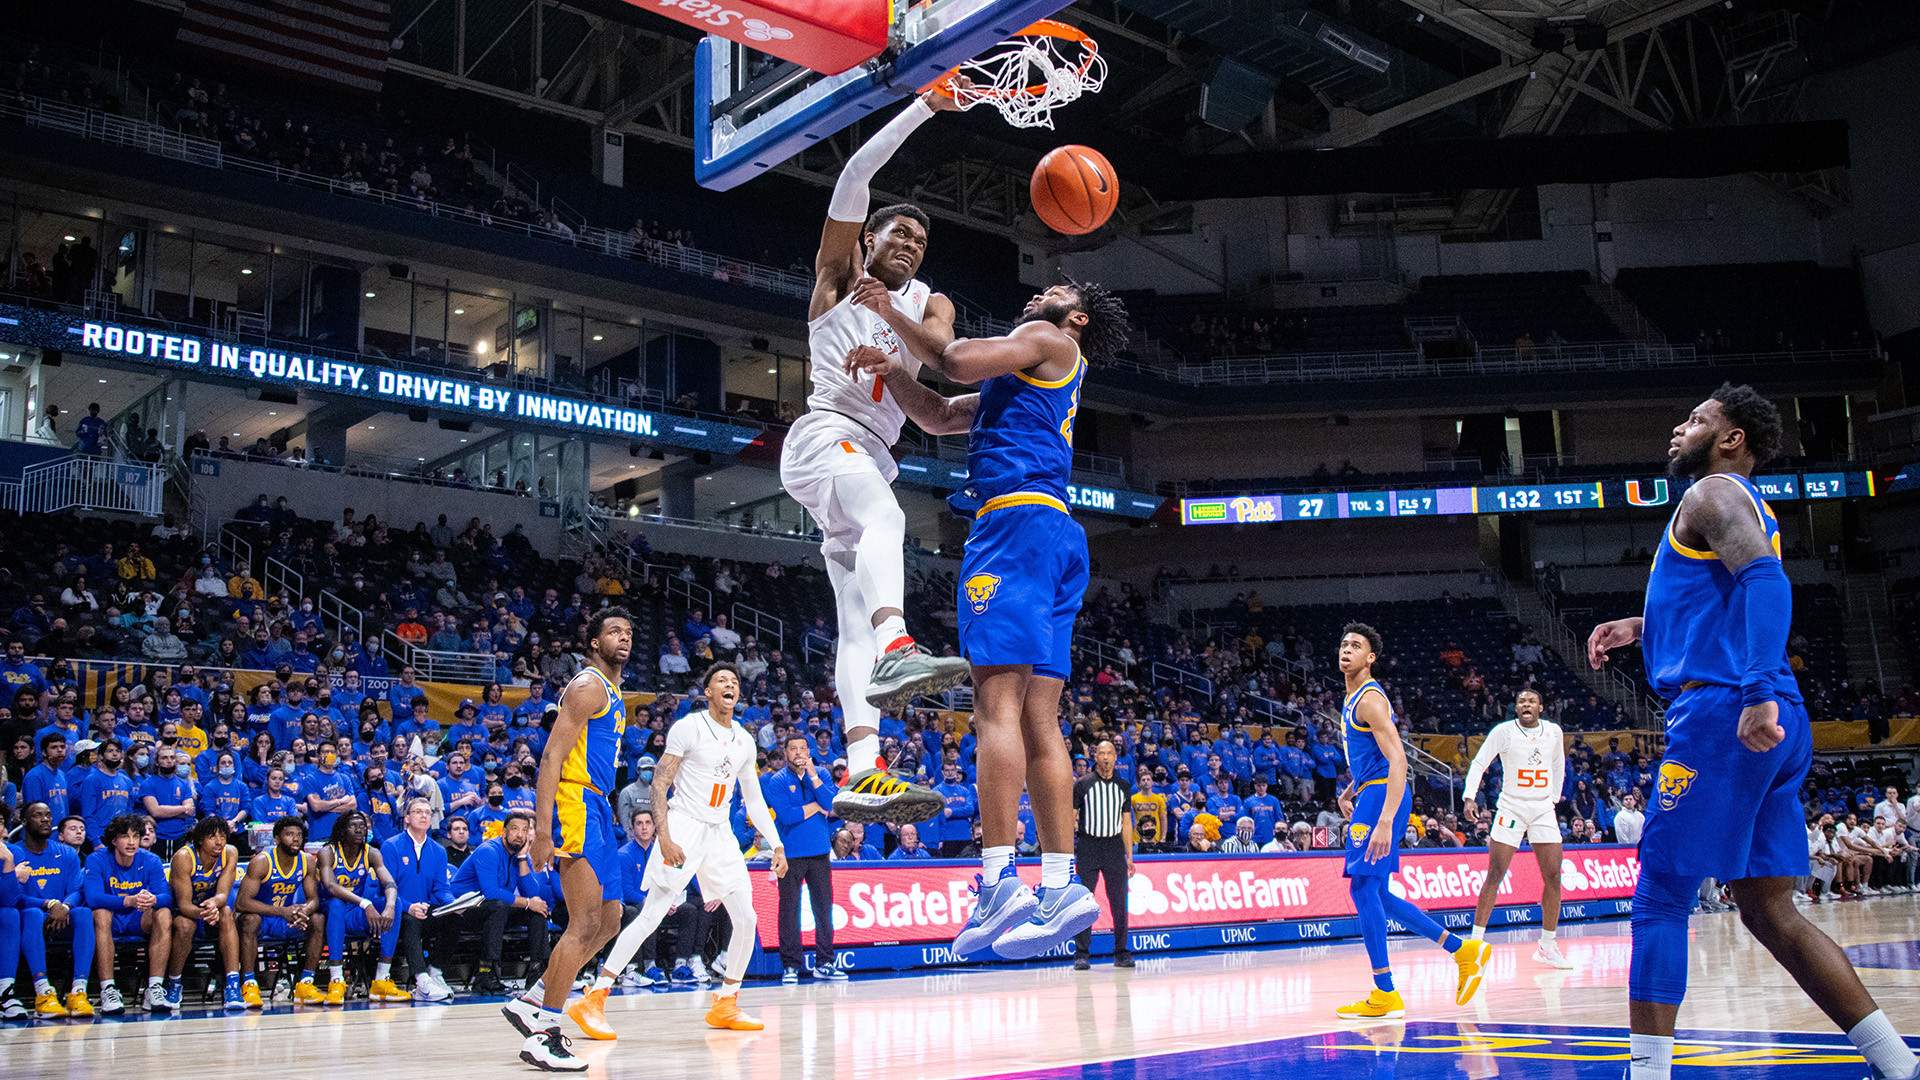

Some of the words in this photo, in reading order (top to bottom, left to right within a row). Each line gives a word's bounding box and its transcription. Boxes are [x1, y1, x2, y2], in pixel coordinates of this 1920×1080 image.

[82, 322, 200, 363] ROOTED
[211, 343, 239, 369] IN
[249, 350, 369, 390] QUALITY.
[378, 371, 470, 407] DRIVEN
[478, 387, 511, 412] BY
[518, 395, 659, 437] INNOVATION.
[1760, 484, 1781, 495] TOL
[1784, 482, 1793, 494] 4
[1806, 482, 1826, 492] FLS
[1830, 480, 1839, 492] 7
[1350, 500, 1371, 511] TOL
[1375, 499, 1385, 512] 3
[1398, 499, 1419, 510] FLS
[1422, 497, 1432, 510] 7
[1497, 490, 1541, 510] 1:32
[1554, 489, 1583, 505] 1ST
[1230, 496, 1276, 523] Pitt
[1299, 499, 1323, 517] 27
[367, 680, 389, 690] ZOO
[1517, 769, 1549, 789] 55
[709, 783, 727, 807] 11
[271, 882, 296, 895] Pitt
[1562, 905, 1587, 918] UPMC
[1615, 901, 1633, 914] UPM
[1444, 913, 1471, 928] UPMC
[1506, 909, 1532, 923] UPMC
[1221, 927, 1257, 943] UPMC
[1298, 922, 1331, 938] UPMC
[1133, 934, 1171, 950] UPMC
